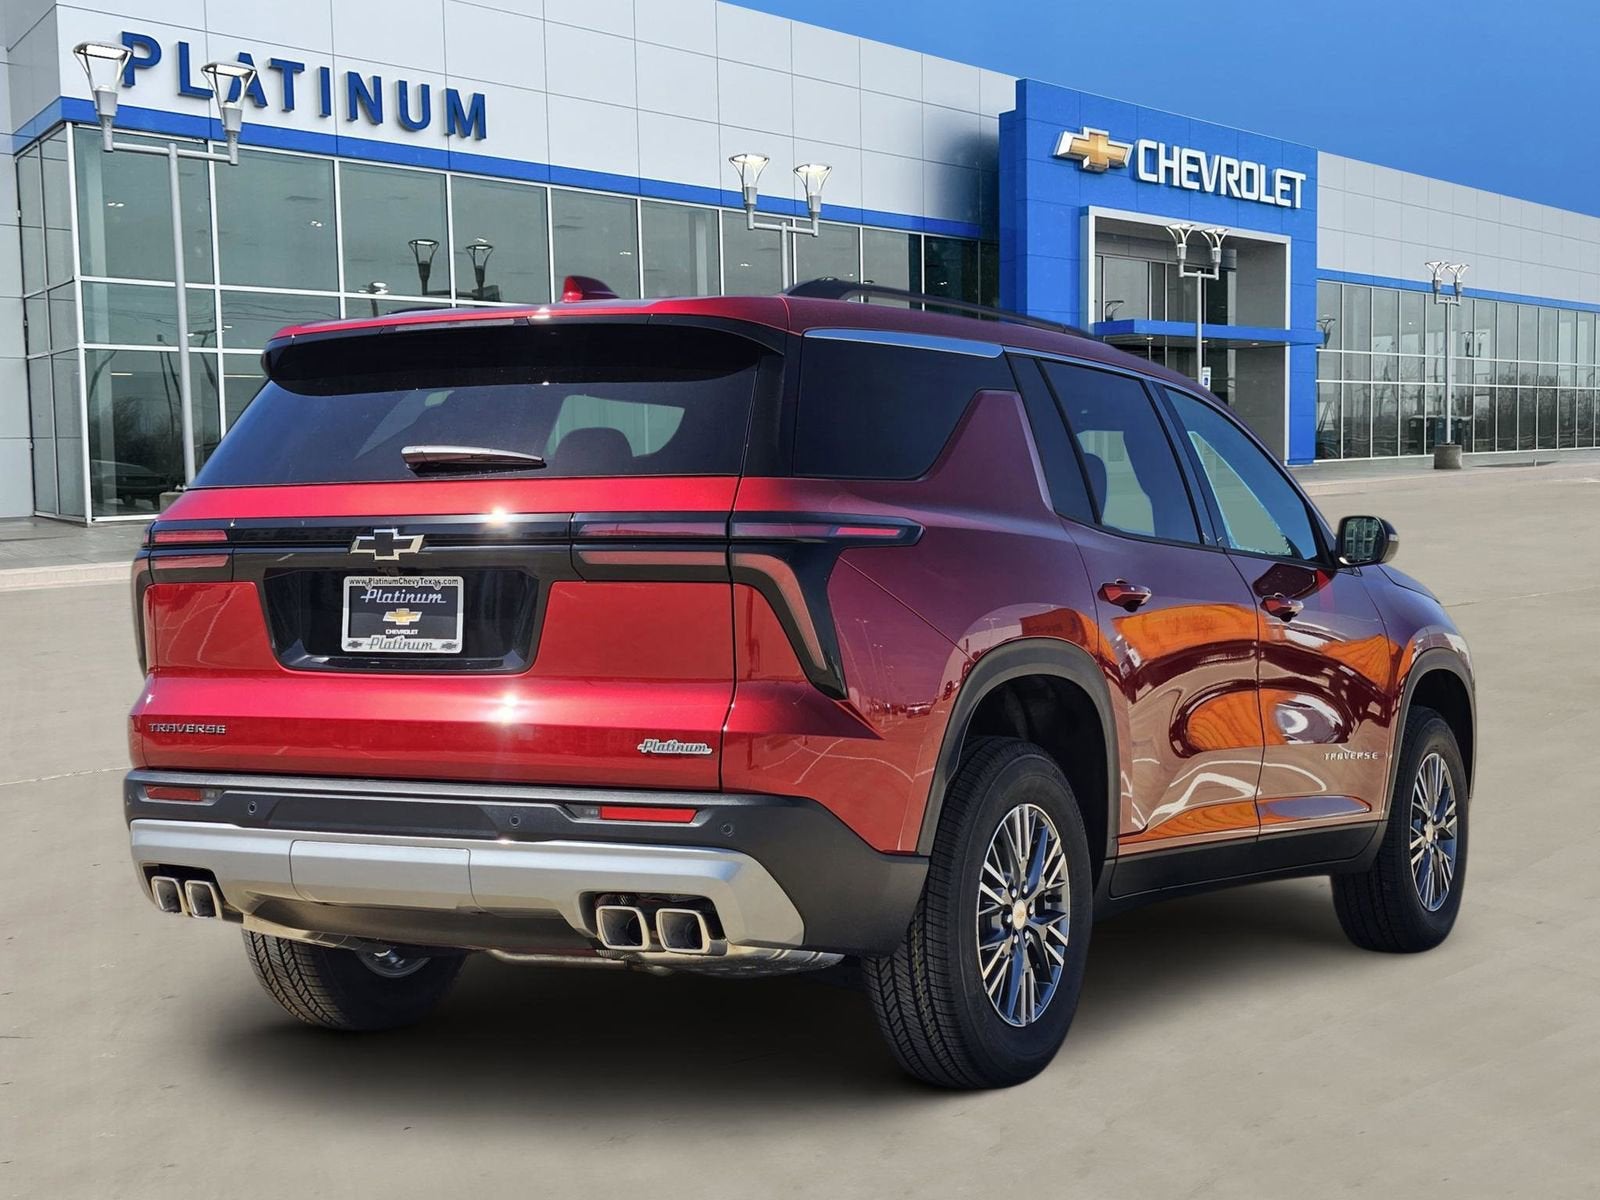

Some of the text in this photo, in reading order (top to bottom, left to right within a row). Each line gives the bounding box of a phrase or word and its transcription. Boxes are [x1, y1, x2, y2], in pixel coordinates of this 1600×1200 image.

[121, 31, 487, 140] PLATINUM
[1137, 139, 1306, 209] CHEVROLET
[360, 588, 447, 604] Platinum
[366, 635, 437, 651] Platinum
[148, 723, 226, 734] TRAVERSE
[638, 739, 713, 754] Platinum
[1324, 752, 1378, 760] TRAVERSE
